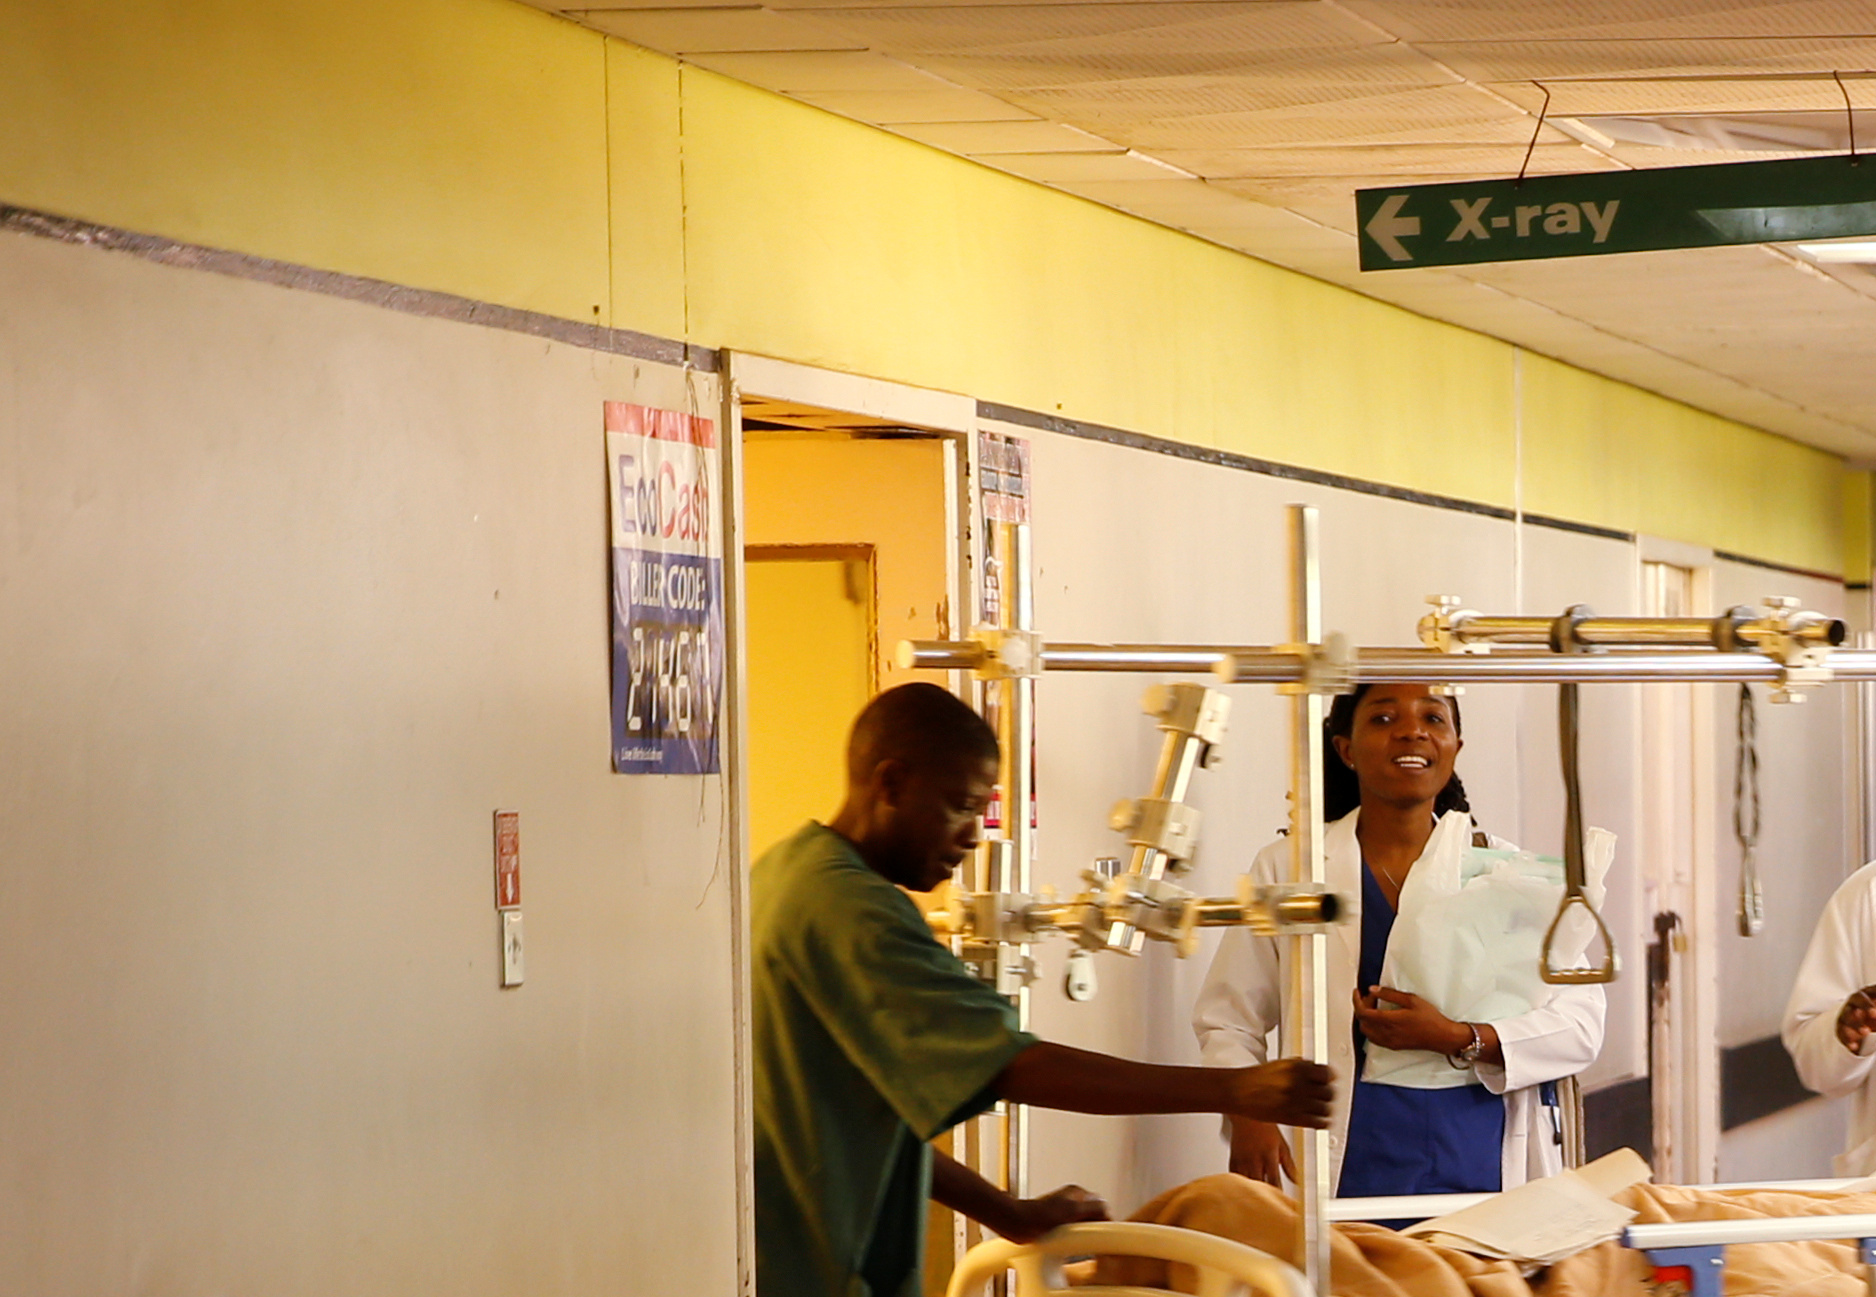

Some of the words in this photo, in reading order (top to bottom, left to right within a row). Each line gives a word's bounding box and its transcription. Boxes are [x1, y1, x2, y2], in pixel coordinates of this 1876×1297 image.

[1445, 197, 1620, 243] X-ray
[619, 454, 709, 542] EcoCash
[630, 560, 665, 608] BILLER
[667, 564, 706, 611] CODE:
